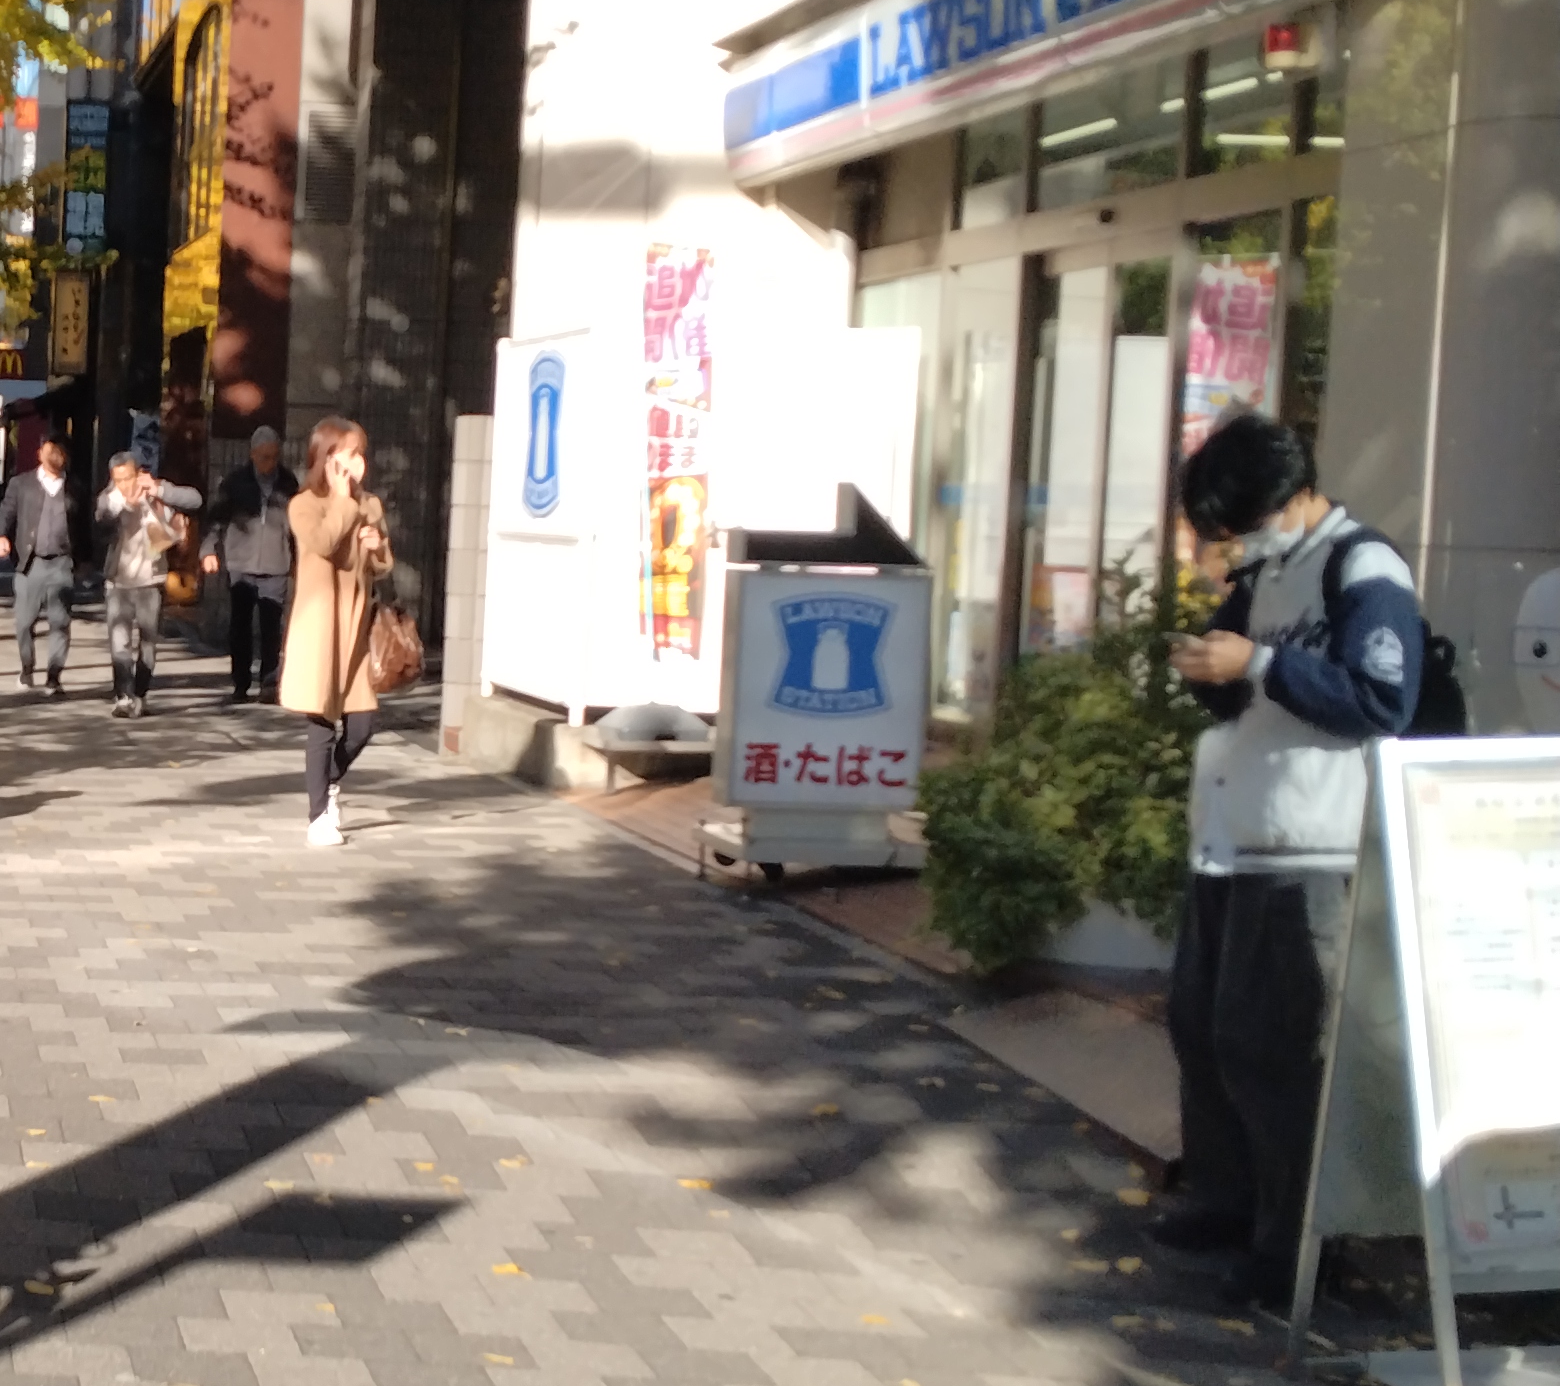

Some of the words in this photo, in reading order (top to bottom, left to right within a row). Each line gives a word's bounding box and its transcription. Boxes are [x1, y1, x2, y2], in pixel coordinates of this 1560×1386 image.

[743, 742, 909, 788] 酒・たばこ
